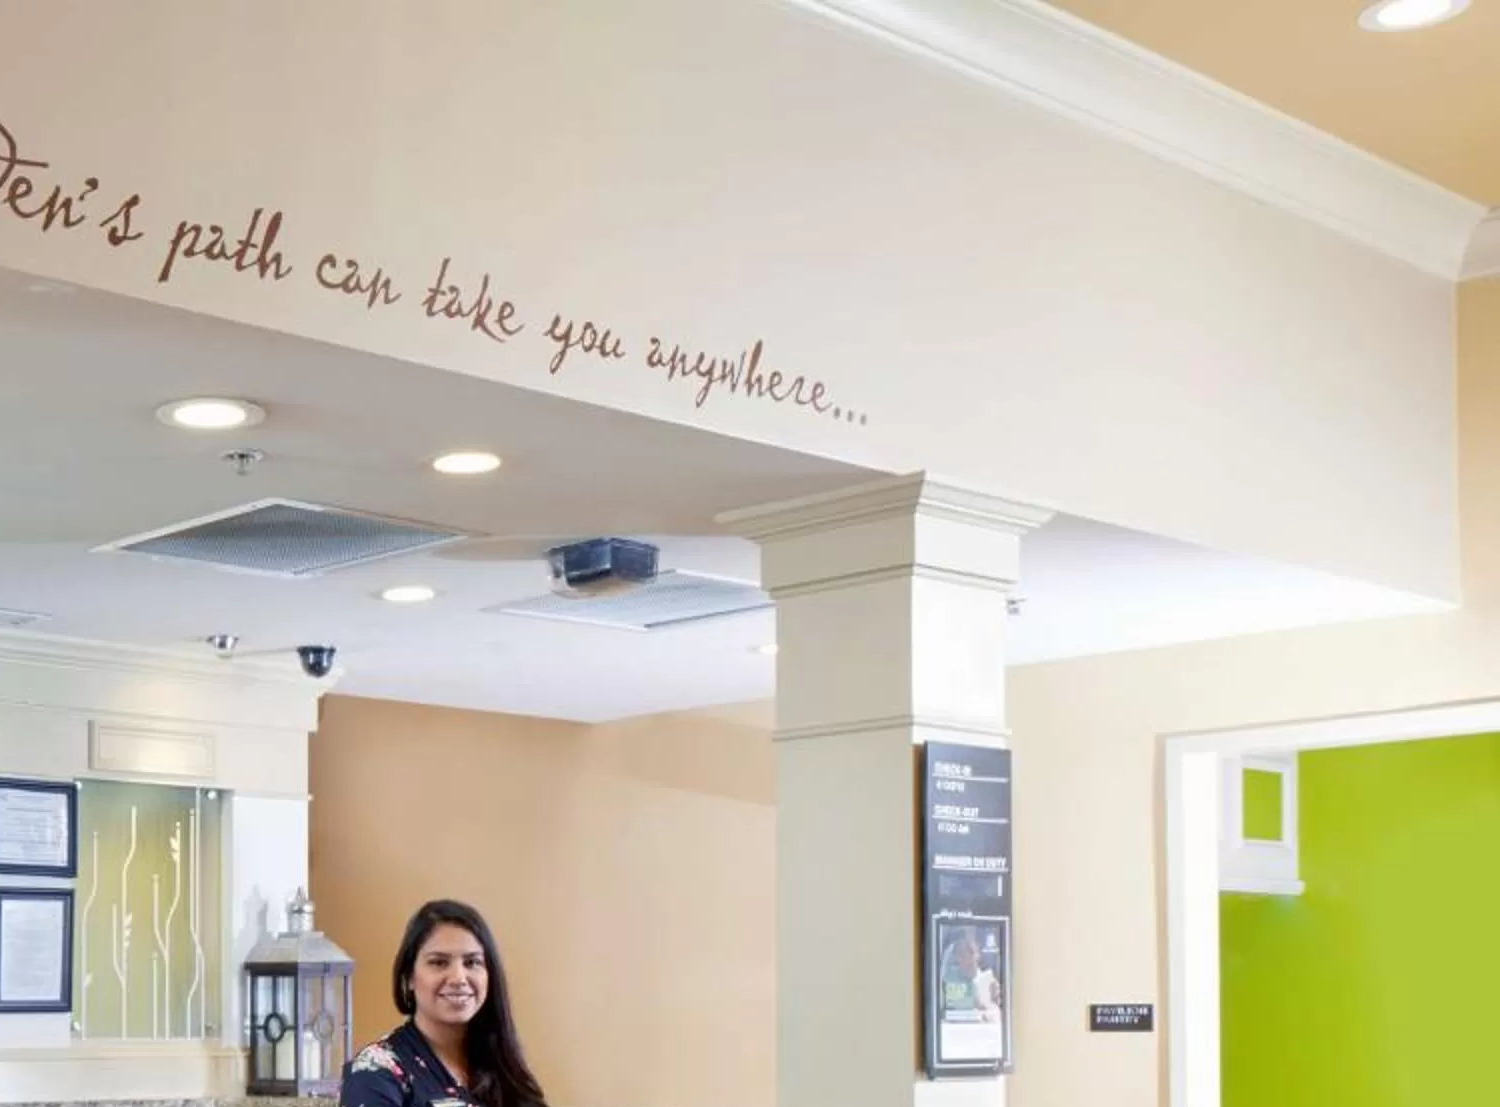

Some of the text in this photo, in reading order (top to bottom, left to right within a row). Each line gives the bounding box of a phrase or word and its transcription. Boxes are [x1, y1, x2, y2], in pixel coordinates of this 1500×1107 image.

[157, 207, 293, 284] path
[315, 253, 403, 310] can
[421, 257, 525, 344] take
[543, 314, 626, 376] you
[646, 336, 868, 427] anywhere...
